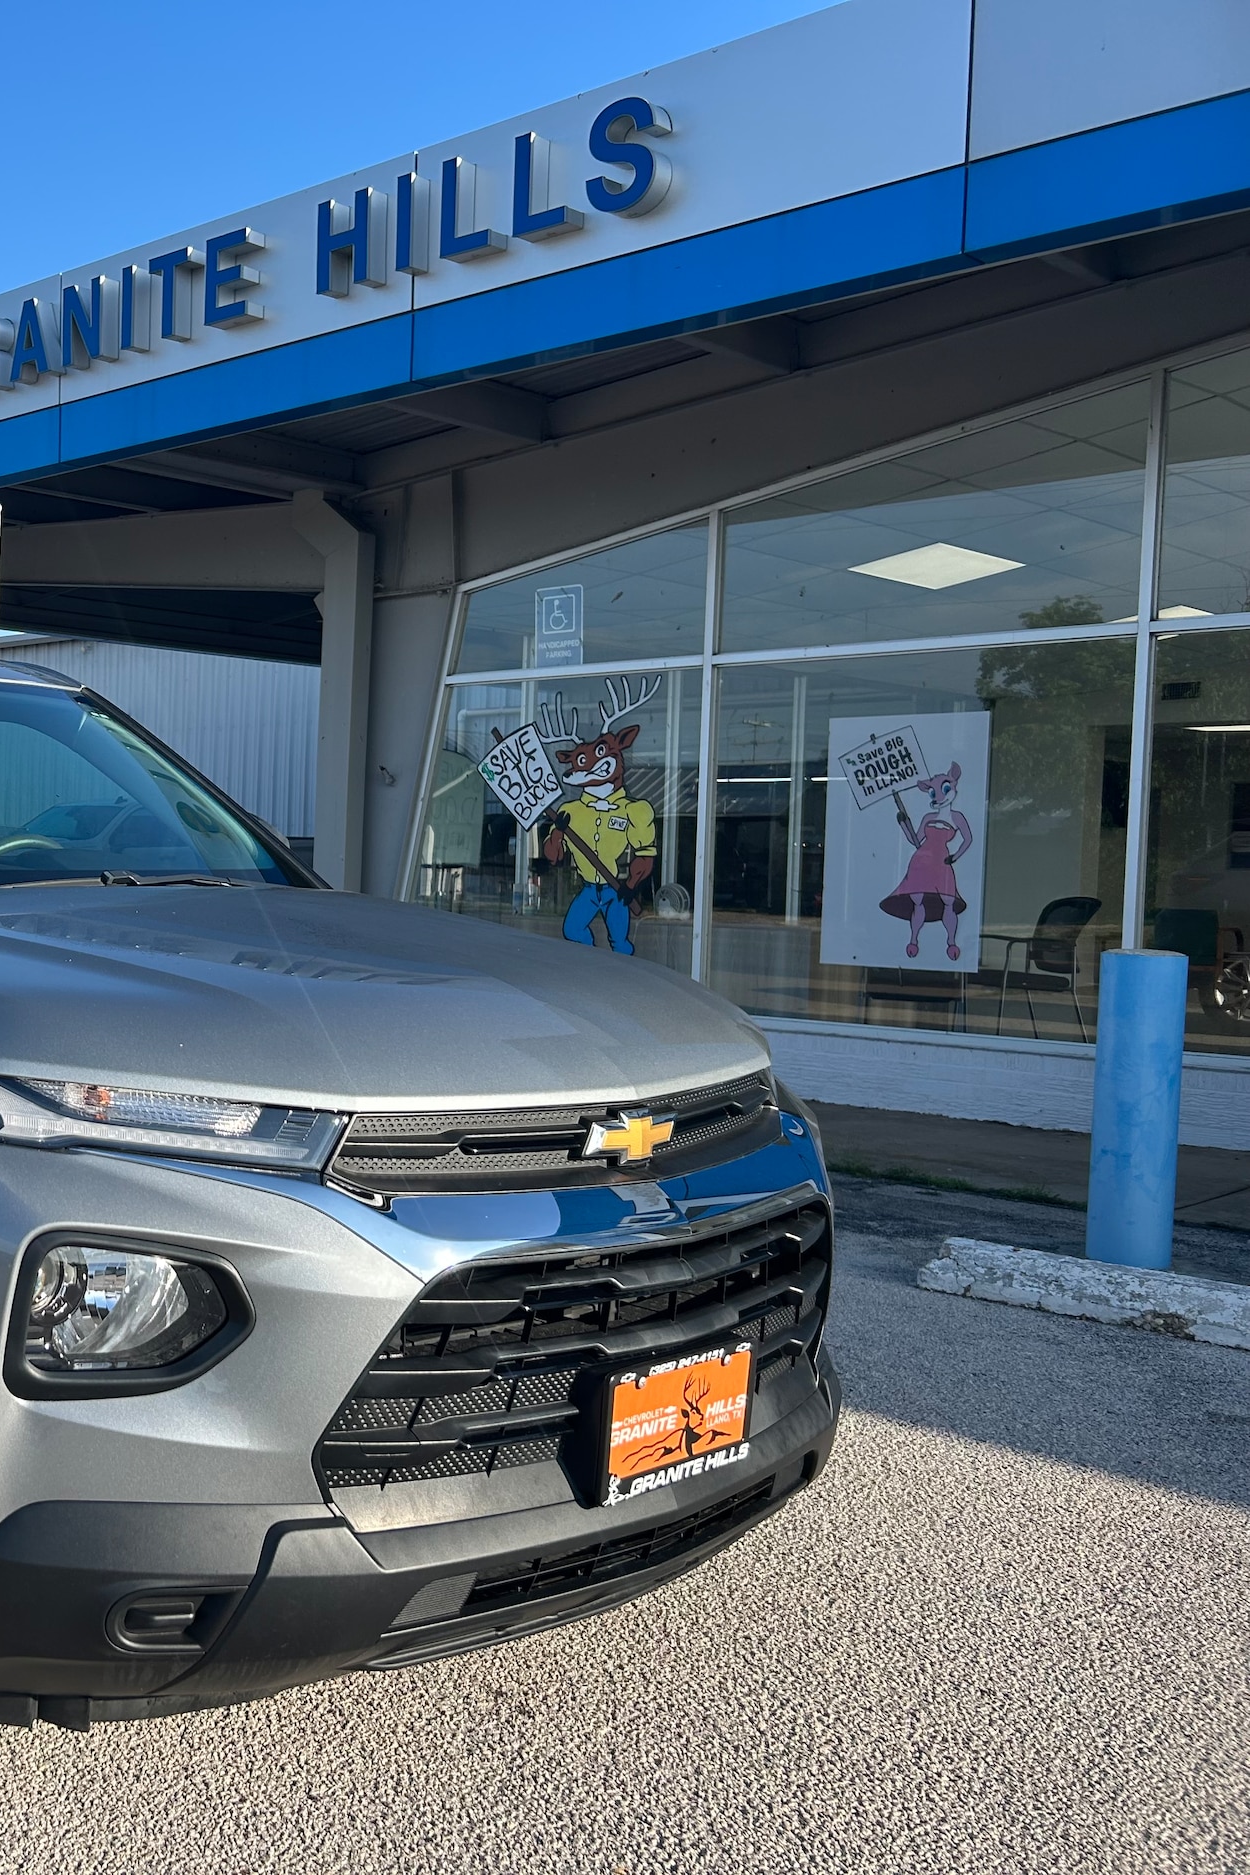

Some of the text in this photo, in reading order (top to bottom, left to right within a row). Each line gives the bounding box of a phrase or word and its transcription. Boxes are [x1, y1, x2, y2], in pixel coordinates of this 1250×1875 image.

[316, 96, 672, 299] HILLS
[538, 639, 580, 649] HANDICAPPED
[490, 730, 537, 776] SAVE
[853, 746, 913, 786] DOUGH
[857, 748, 883, 764] Save
[884, 736, 904, 752] BIG
[498, 755, 543, 800] BIG
[514, 773, 559, 820] BUCKS
[875, 764, 918, 790] LLANO!
[649, 1361, 676, 1376] (325)
[610, 1393, 747, 1447] GRANITE HILLS
[623, 1407, 664, 1426] CHEVROLET
[732, 1409, 743, 1421] TX
[630, 1441, 750, 1496] GRANITE HILLS
